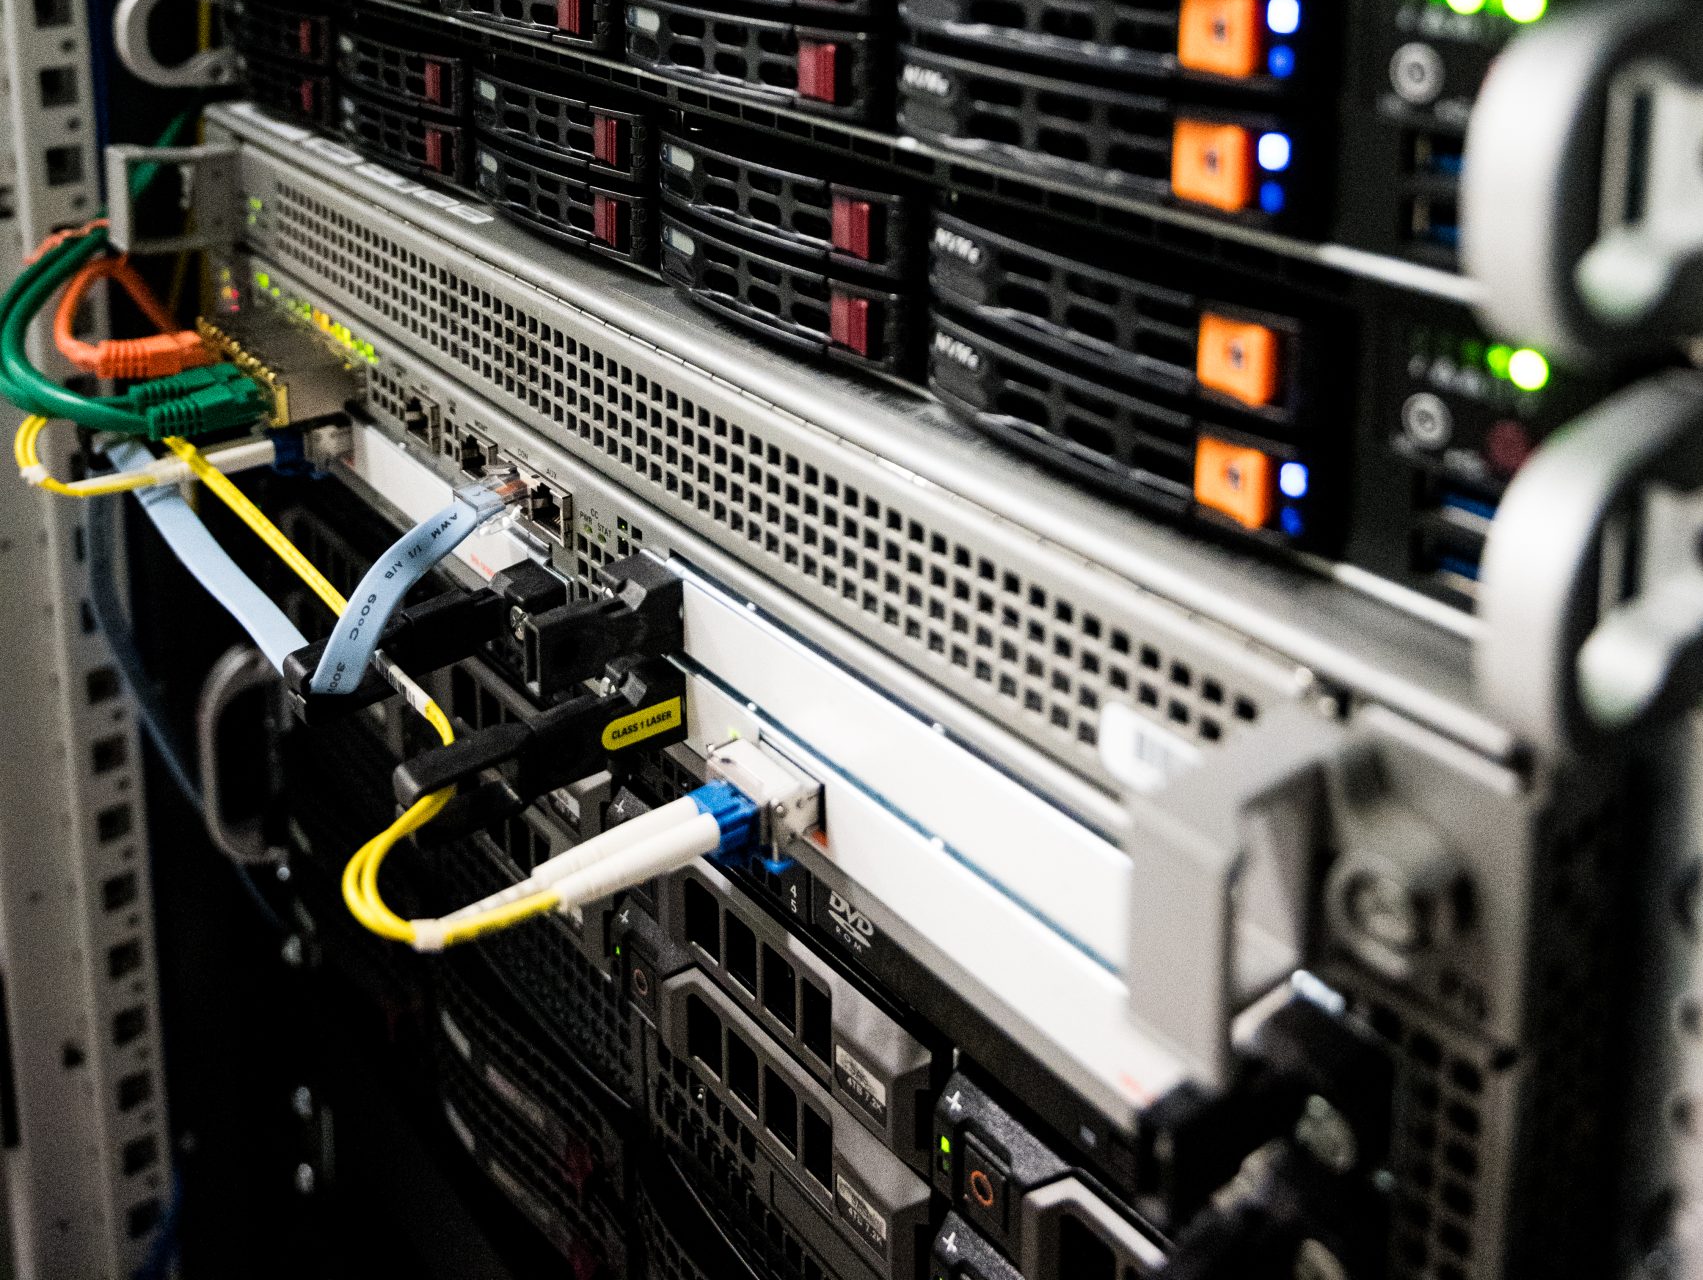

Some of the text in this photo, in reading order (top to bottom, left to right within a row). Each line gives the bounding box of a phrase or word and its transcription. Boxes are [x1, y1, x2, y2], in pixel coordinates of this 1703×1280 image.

[580, 511, 593, 526] PWR
[590, 508, 599, 520] CC
[430, 512, 458, 540] AWM
[597, 522, 612, 538] STAT
[384, 560, 404, 580] A/B
[611, 710, 672, 740] CLASS 1 LASER
[790, 884, 797, 899] 4
[790, 898, 797, 914] 5
[829, 889, 875, 936] DVD
[835, 925, 862, 955] ROM
